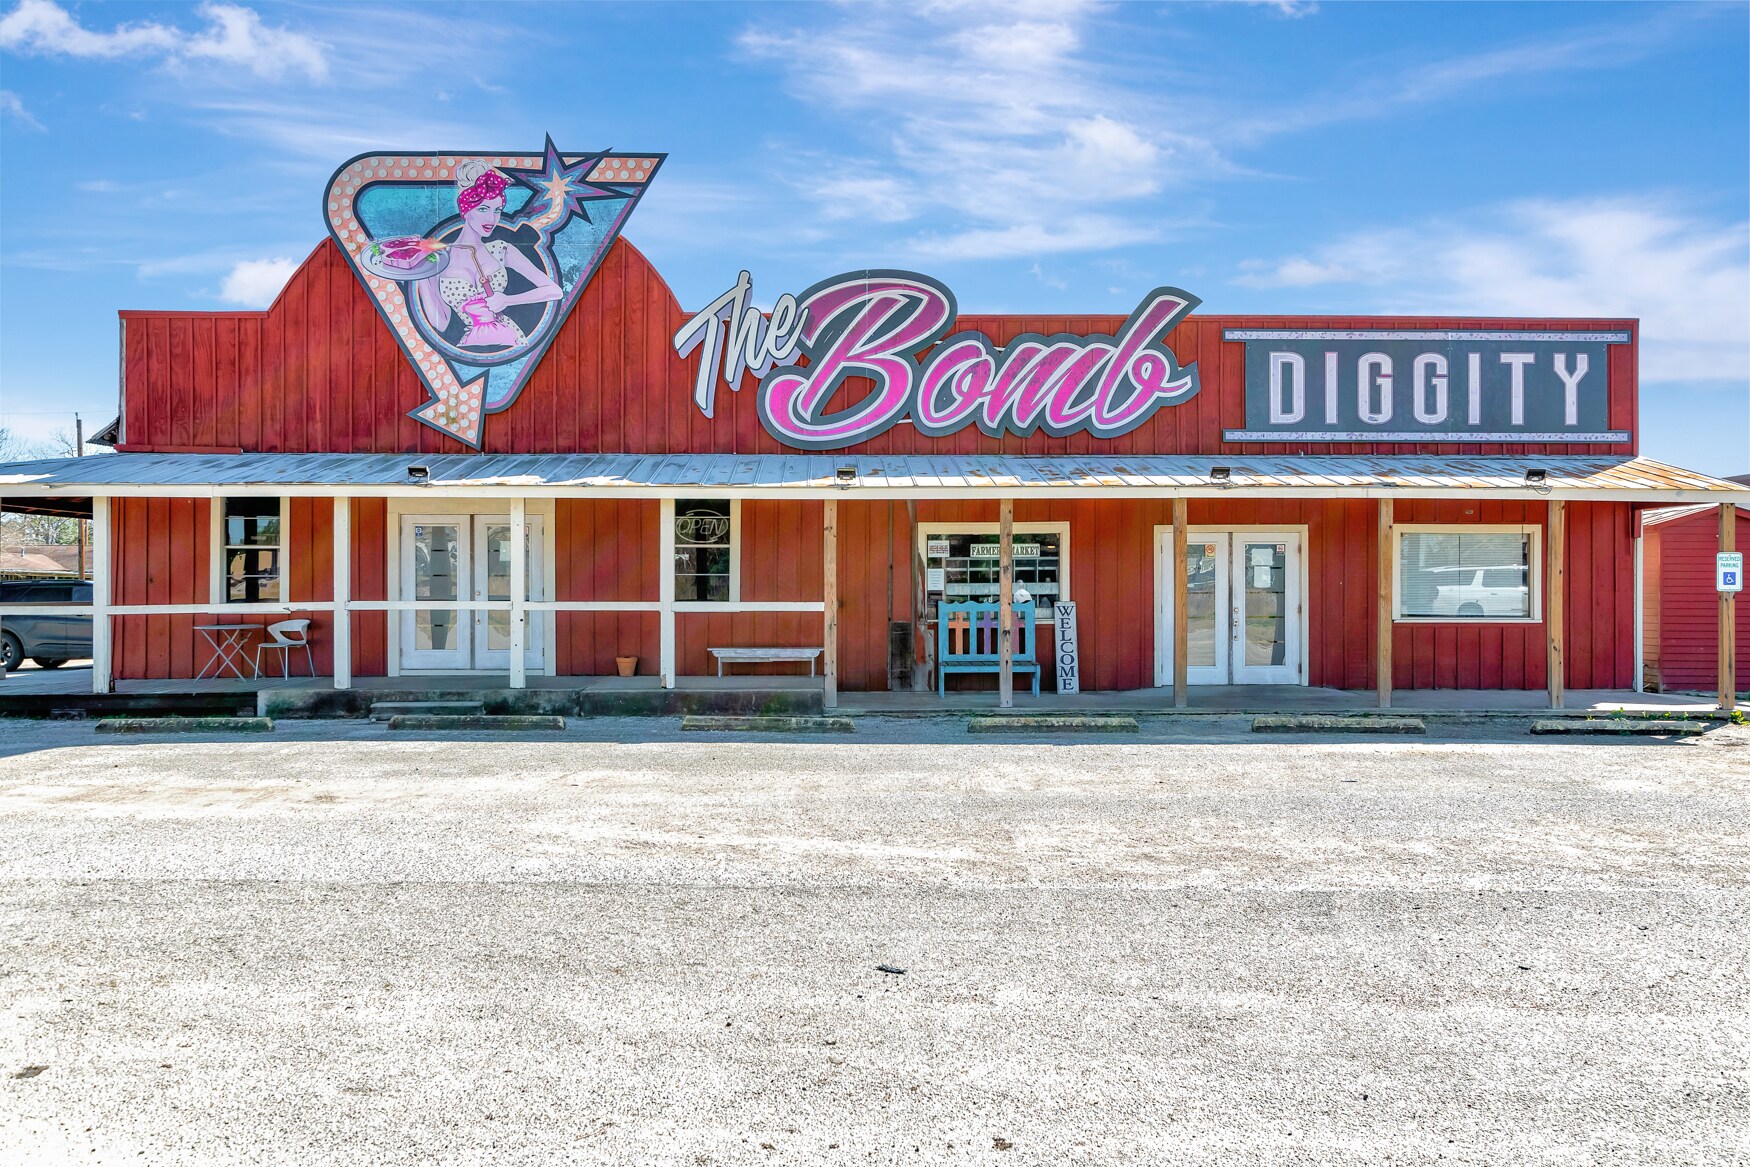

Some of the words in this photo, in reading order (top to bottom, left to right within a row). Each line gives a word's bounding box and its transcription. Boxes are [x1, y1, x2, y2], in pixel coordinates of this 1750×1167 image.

[673, 270, 810, 413] The
[762, 274, 1195, 443] Bomb
[1269, 351, 1590, 426] DIGGITY
[678, 518, 724, 535] OPEN
[1056, 605, 1076, 691] WELCOME
